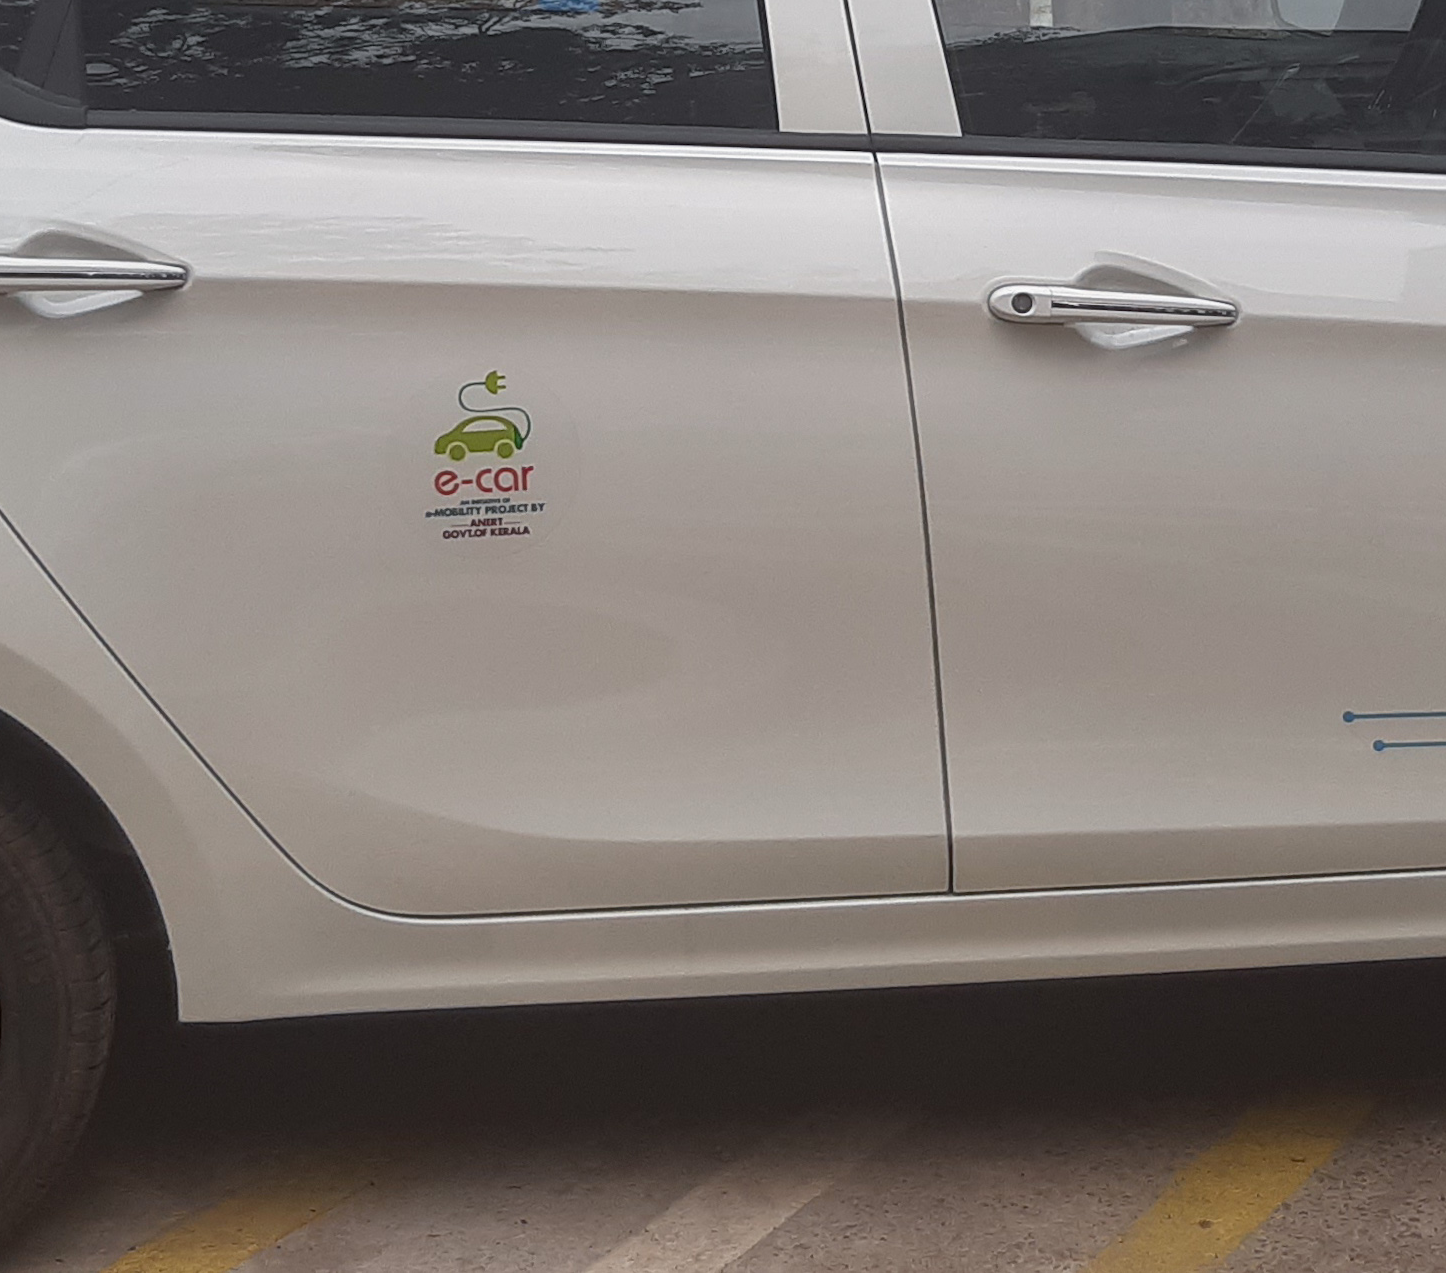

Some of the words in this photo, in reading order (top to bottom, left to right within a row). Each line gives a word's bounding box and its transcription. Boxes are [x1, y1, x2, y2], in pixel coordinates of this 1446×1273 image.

[434, 465, 534, 496] e-car
[485, 503, 528, 515] PROJECT
[531, 502, 545, 512] BY
[470, 517, 504, 527] ANERT
[490, 526, 531, 536] KERALA
